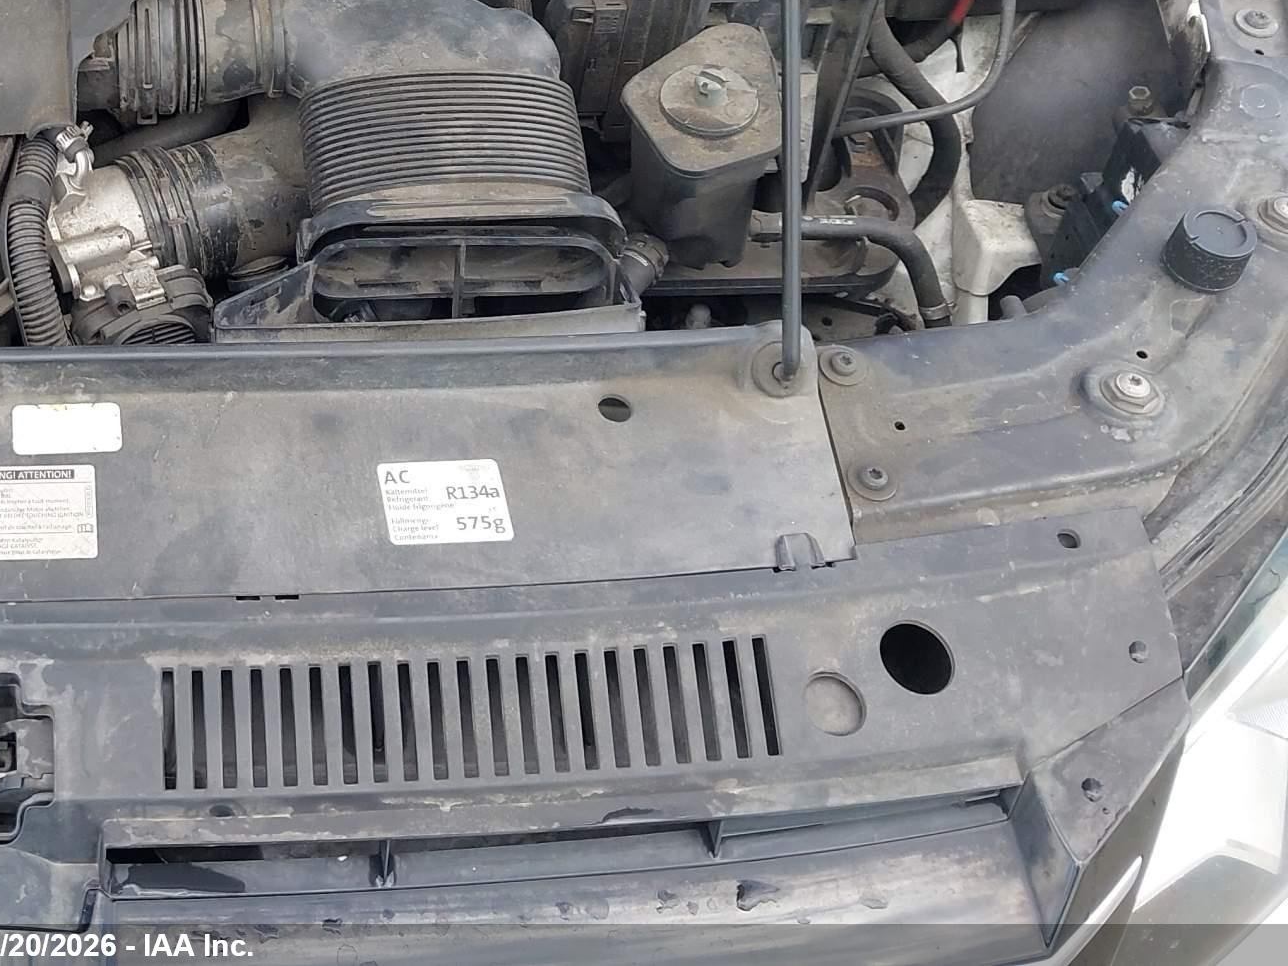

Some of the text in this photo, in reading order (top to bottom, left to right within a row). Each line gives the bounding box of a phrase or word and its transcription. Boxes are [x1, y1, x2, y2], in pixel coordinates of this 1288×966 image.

[17, 470, 72, 480] ATTENTION!
[446, 485, 500, 500] R134a
[456, 515, 506, 534] 575g
